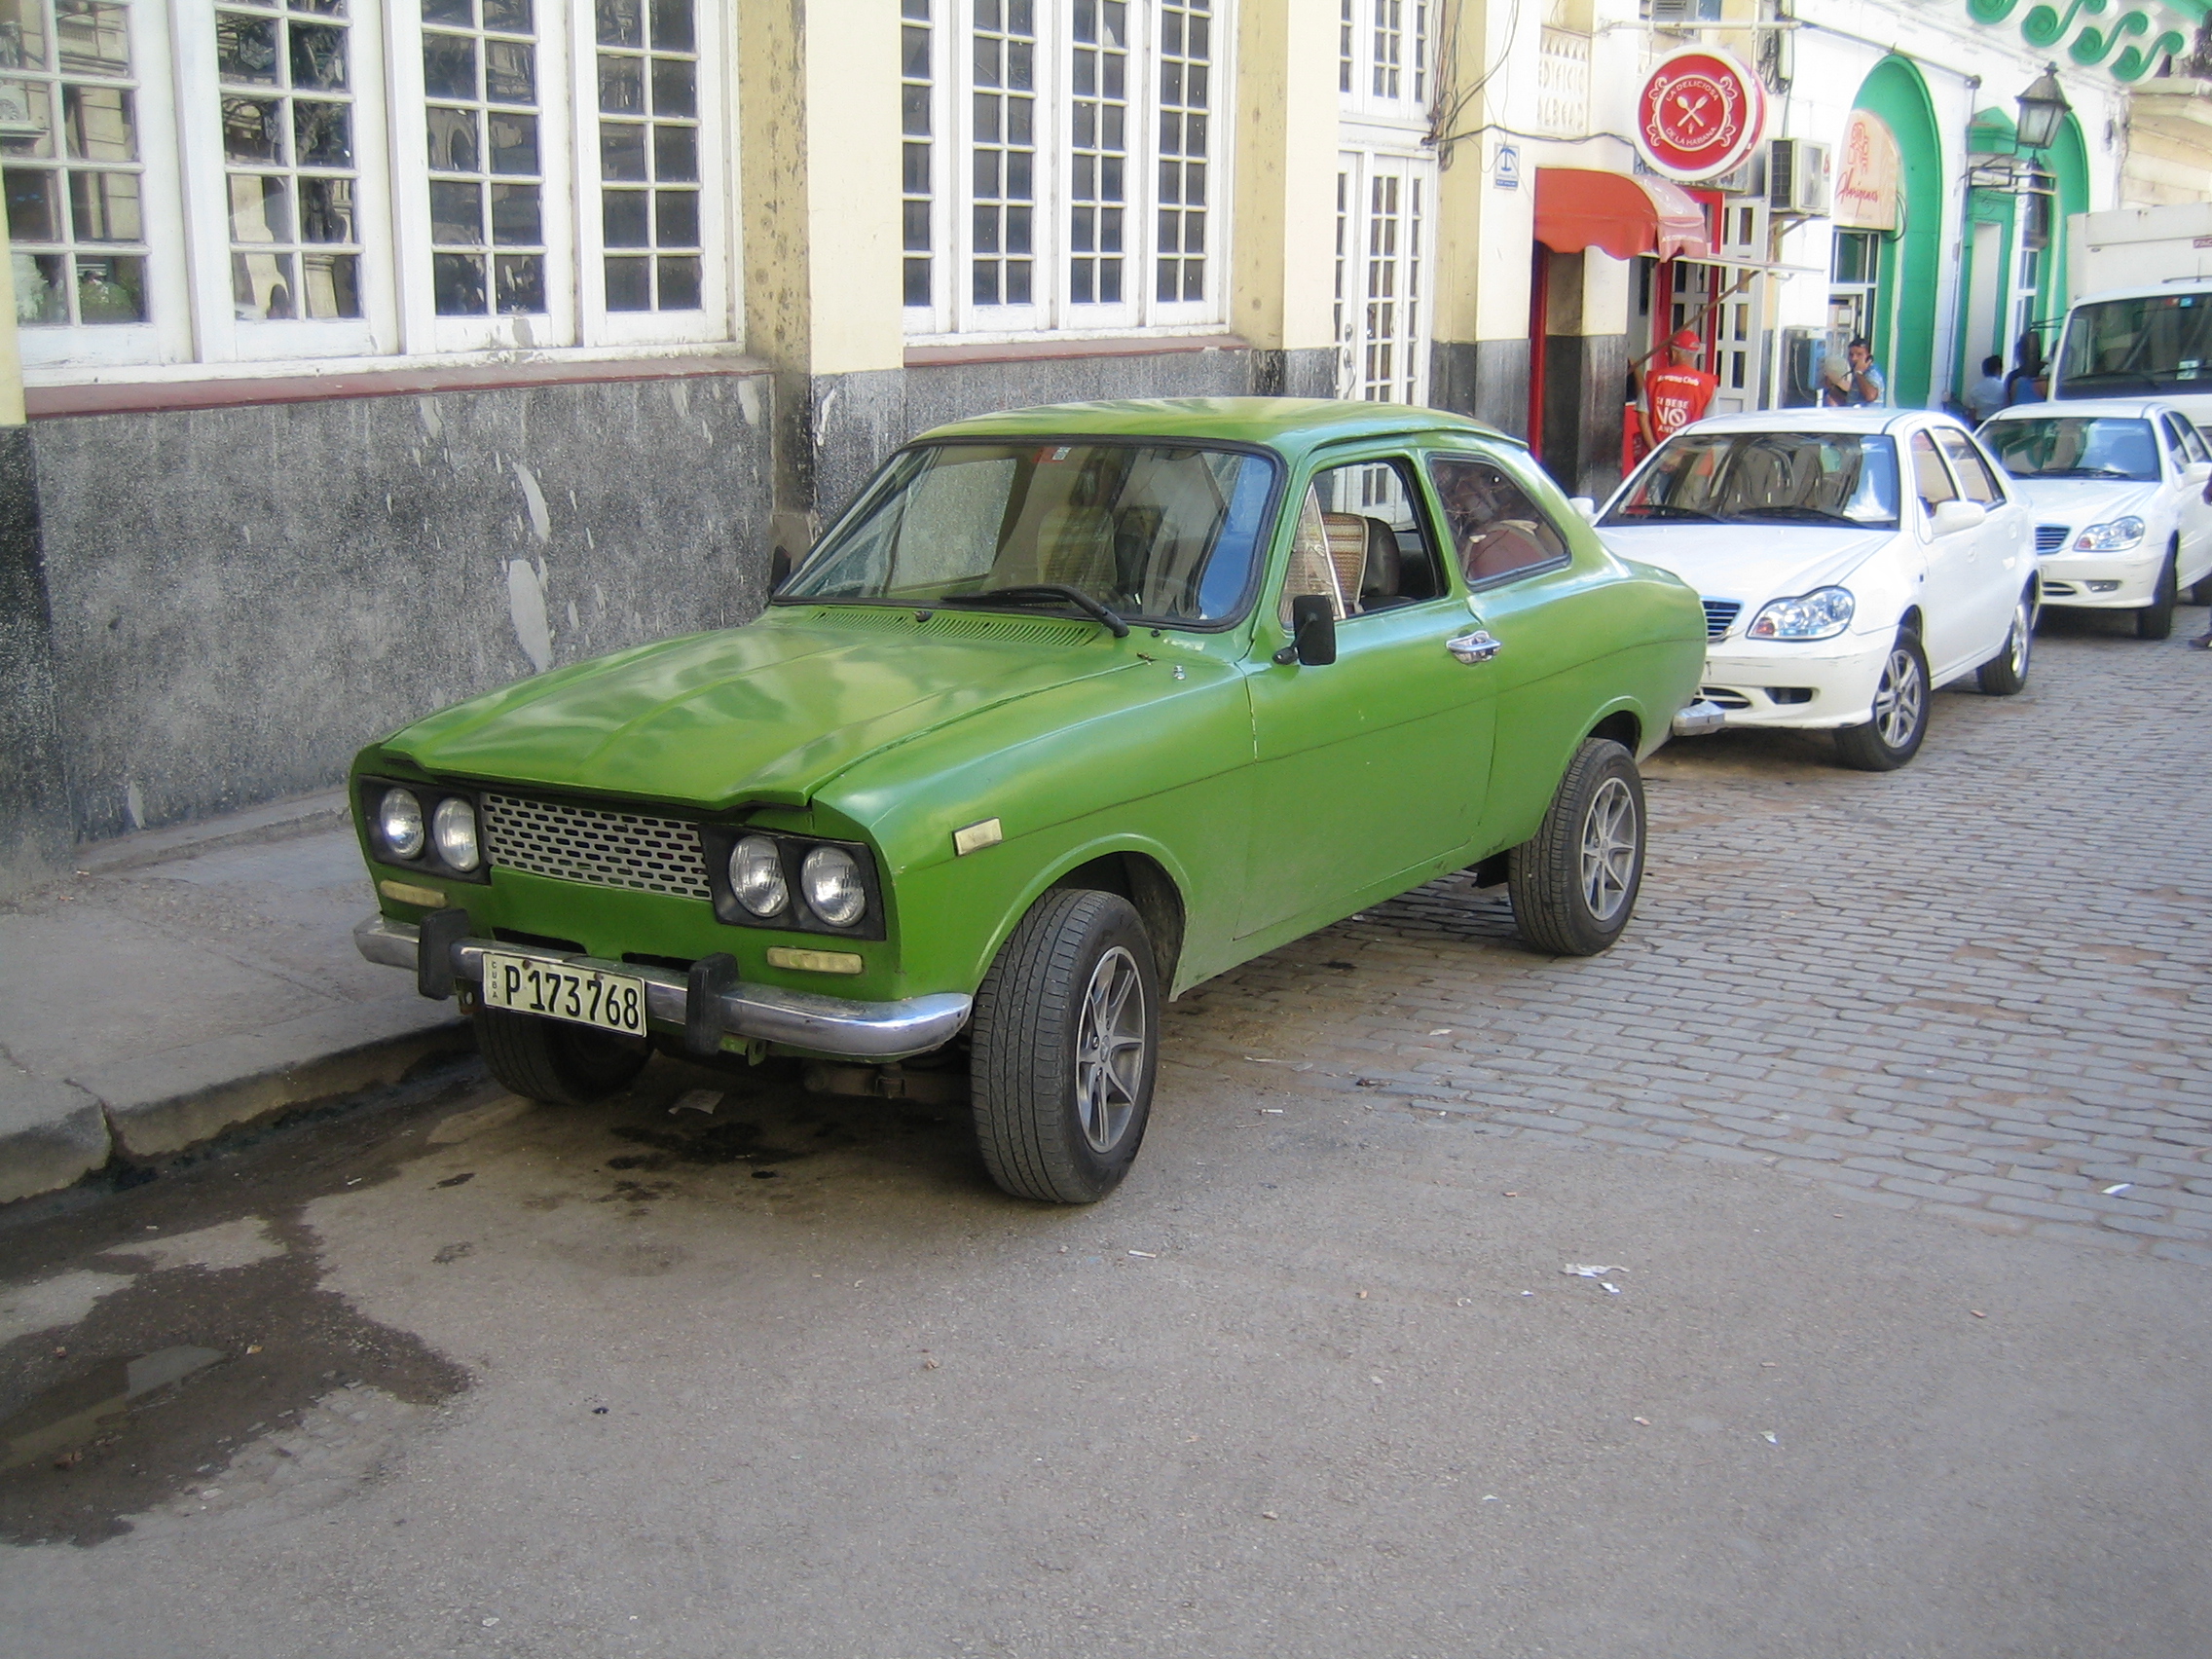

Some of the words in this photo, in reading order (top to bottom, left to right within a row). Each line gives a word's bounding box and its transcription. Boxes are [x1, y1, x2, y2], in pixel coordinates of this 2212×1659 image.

[1666, 90, 1677, 102] LA
[1677, 80, 1720, 102] DELICIOSA
[1666, 128, 1676, 140] DE
[1676, 136, 1685, 146] LA
[1685, 127, 1717, 146] HABANA
[1683, 376, 1700, 387] Club
[1665, 397, 1688, 408] BEBE
